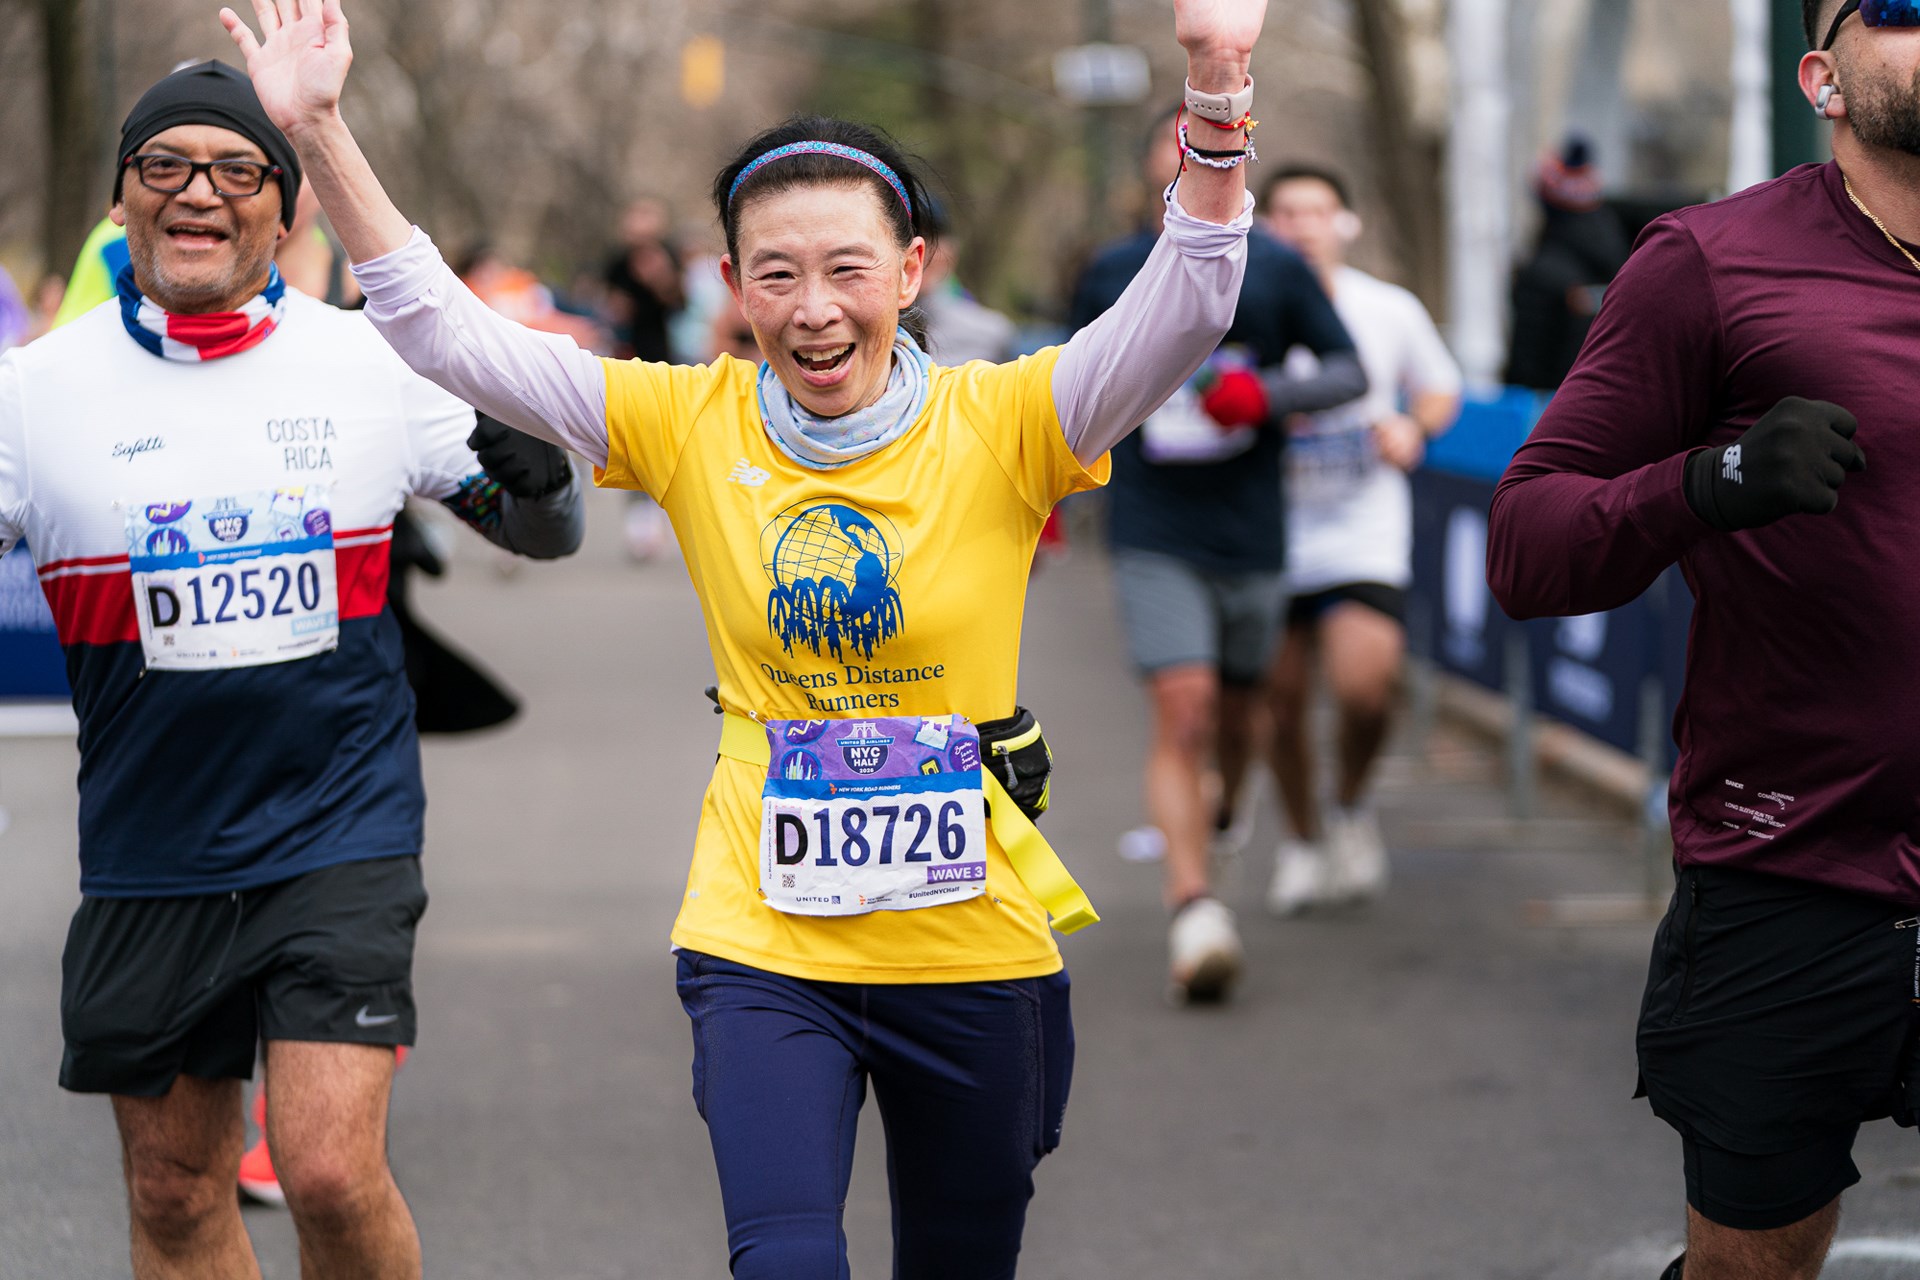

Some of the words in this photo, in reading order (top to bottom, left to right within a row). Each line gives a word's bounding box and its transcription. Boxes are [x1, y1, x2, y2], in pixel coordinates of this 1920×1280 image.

[266, 417, 338, 443] COSTA
[111, 434, 167, 462] Safetti
[284, 446, 334, 471] RICA
[761, 663, 838, 689] Queens
[844, 663, 945, 686] Distance
[804, 692, 900, 712] Runners
[851, 747, 880, 758] NYC
[854, 759, 878, 767] HALF
[931, 867, 971, 881] WAVE
[974, 866, 984, 879] 3
[909, 886, 960, 899] #UnitedNYCHalf
